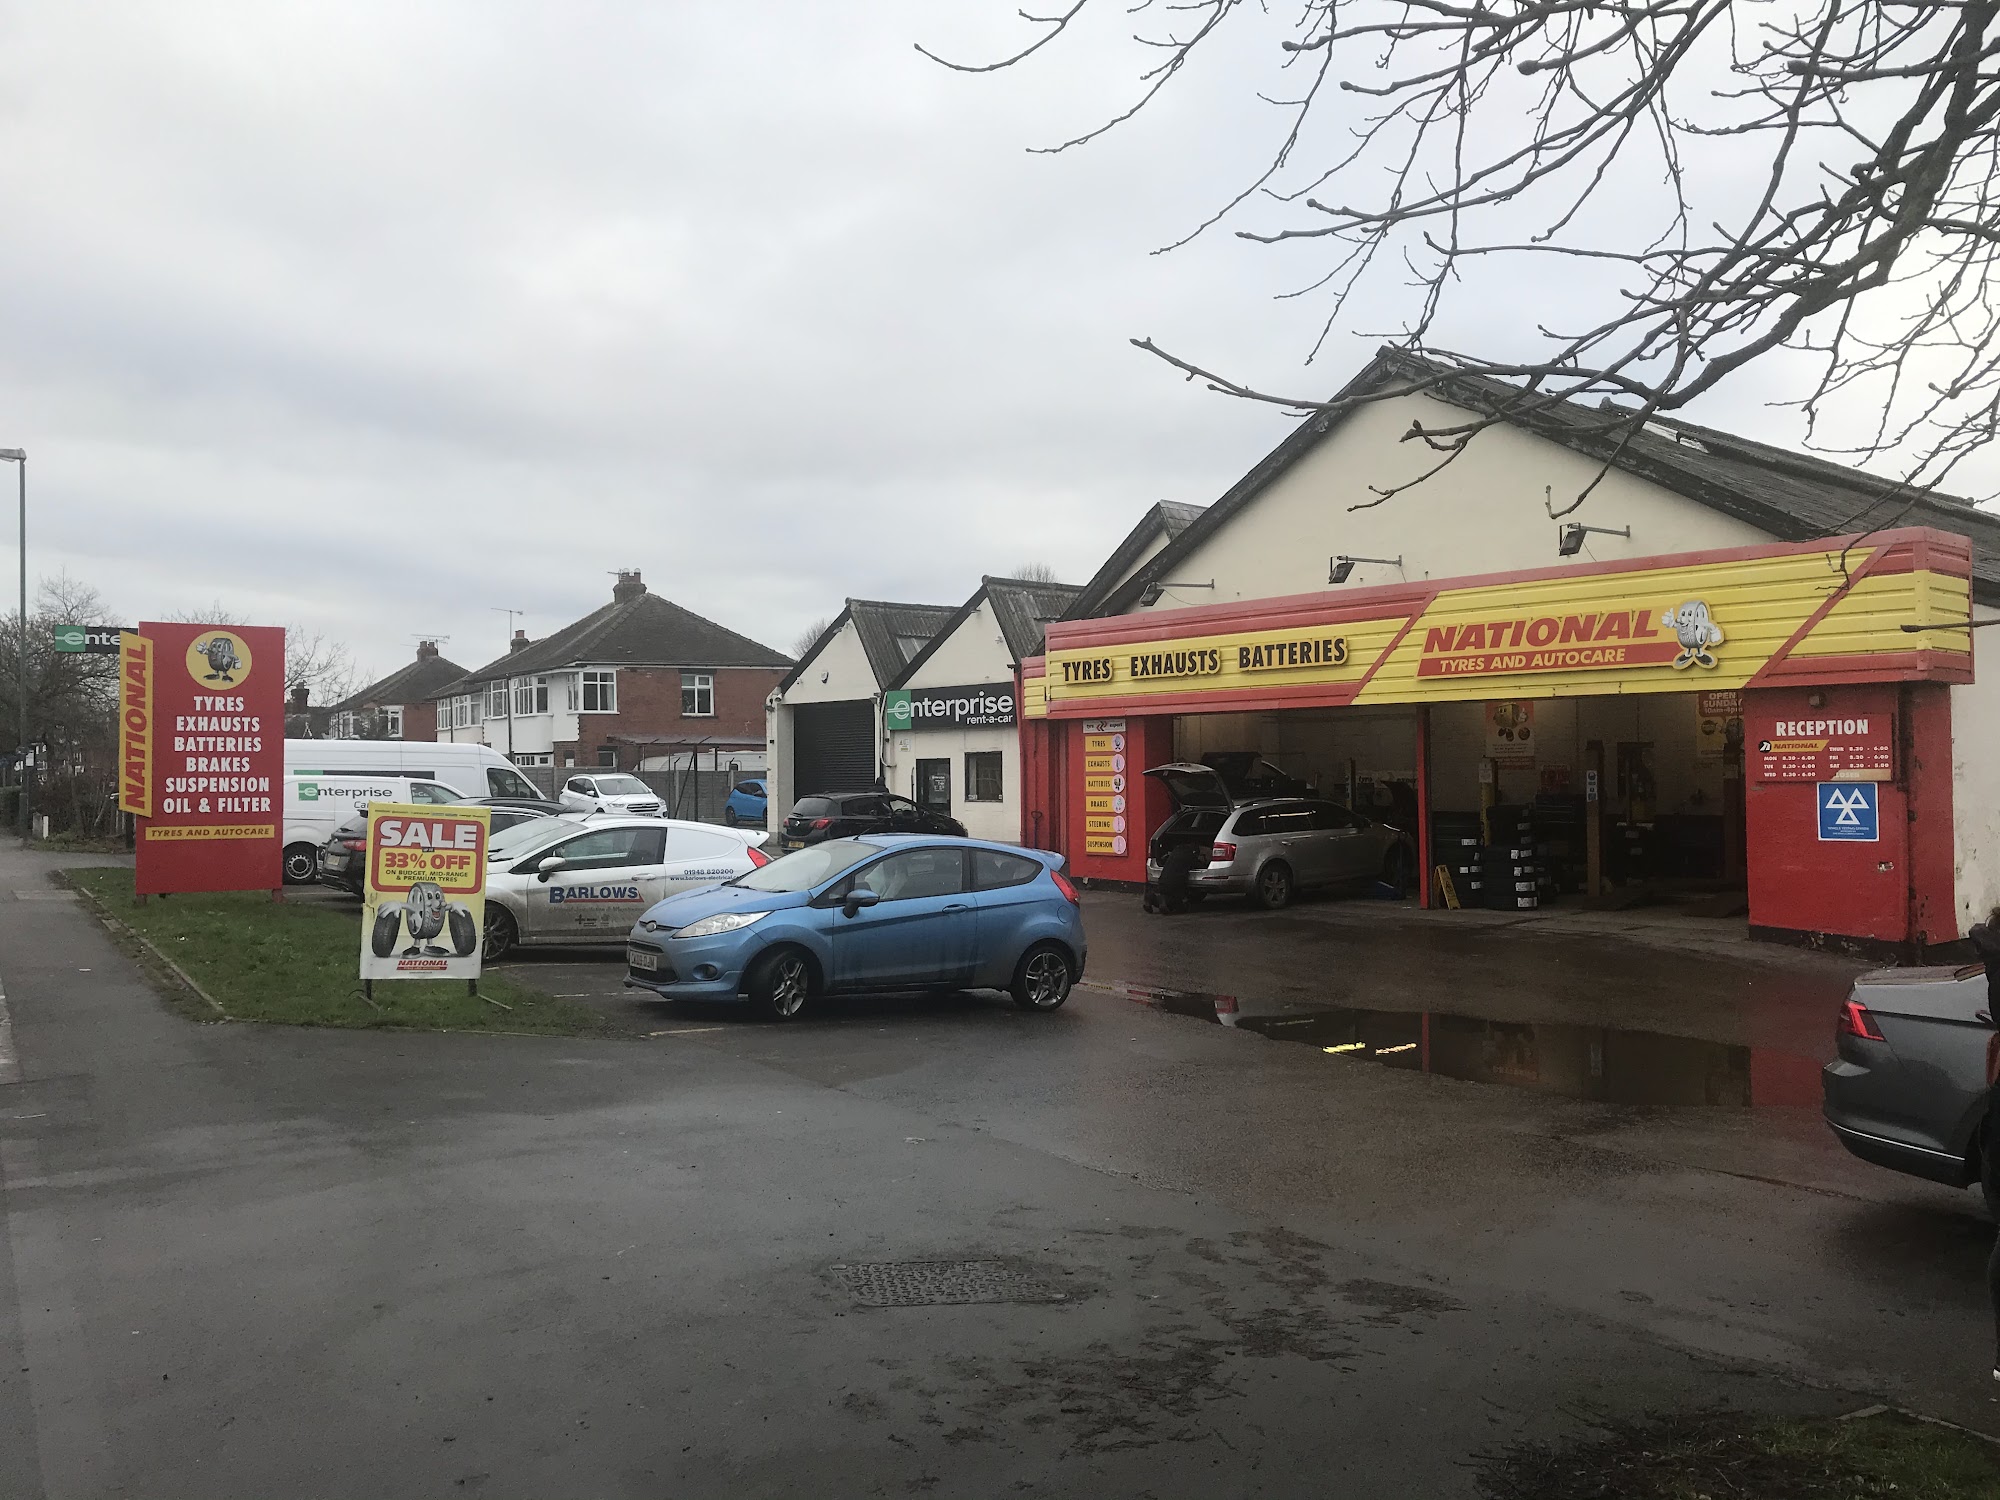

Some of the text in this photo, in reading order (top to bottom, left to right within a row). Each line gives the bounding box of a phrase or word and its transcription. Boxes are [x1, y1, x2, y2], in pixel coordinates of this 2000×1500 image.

[1424, 609, 1659, 654] NATIONAL
[1062, 638, 1345, 682] TYRES EXHAUSTS BATTERIES
[1440, 648, 1626, 673] TYRES AND AUTOCARE
[193, 696, 245, 712] TYRES
[1703, 698, 1743, 707] SUNDAY
[1708, 692, 1737, 700] OPEN
[890, 690, 1014, 722] enterprise
[125, 643, 148, 810] NATIONAL
[176, 716, 261, 732] EXHAUSTS
[966, 714, 1014, 725] rent-a-car
[1776, 719, 1869, 737] RECEPTION
[174, 736, 262, 752] BATTERIES
[1091, 740, 1106, 748] TYRES
[186, 757, 251, 773] BRAKES
[1087, 760, 1111, 768] EXHAUSTS
[165, 777, 270, 793] SUSPENSION
[1087, 780, 1111, 788] BATTERIES
[301, 787, 393, 799] enterprise
[163, 797, 271, 813] OIL & FILTER
[353, 801, 369, 809] Ca
[1090, 800, 1108, 808] BRAKES
[214, 828, 270, 836] AUTOCARE
[1088, 820, 1111, 828] STEERING
[379, 820, 478, 849] SALE
[385, 852, 471, 870] 33% OFF
[549, 886, 638, 904] BARLOWS
